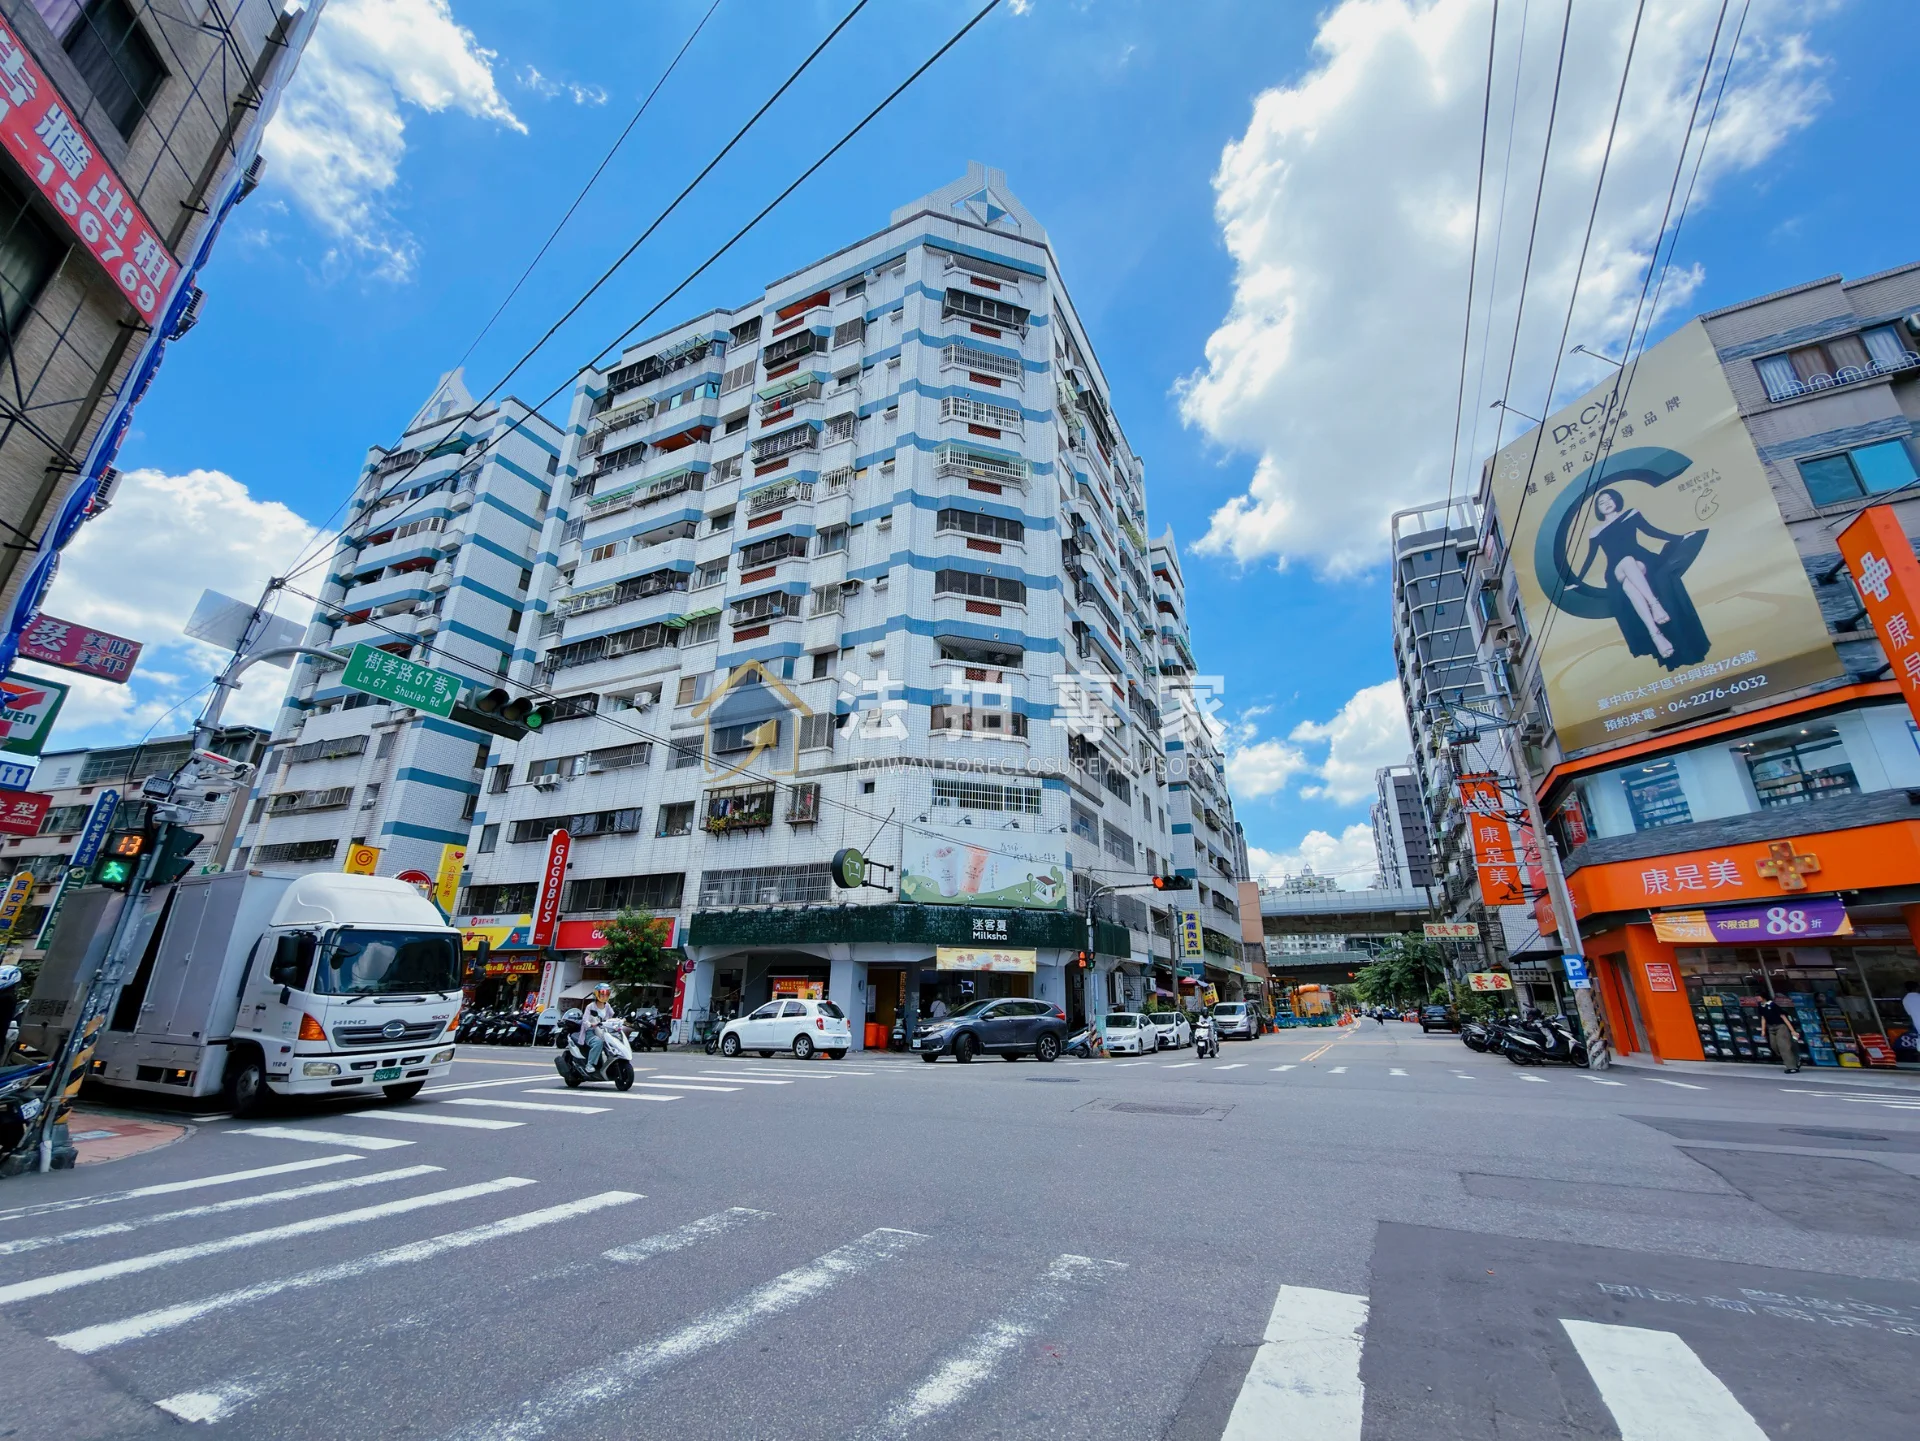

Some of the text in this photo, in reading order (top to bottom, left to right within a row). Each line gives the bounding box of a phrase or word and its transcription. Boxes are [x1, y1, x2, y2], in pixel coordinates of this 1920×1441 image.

[365, 651, 448, 694] 樹孝路67巷
[394, 684, 426, 703] Shuxiao
[429, 696, 441, 708] Rd
[118, 836, 143, 856] 13
[1478, 826, 1512, 887] 康是美
[542, 844, 566, 923] GOGOBUS
[1641, 859, 1744, 896] 康是美
[972, 918, 1008, 932] 迷客夏
[1766, 907, 1807, 935] 88
[1811, 919, 1822, 929] 折
[972, 931, 1008, 941] Milksha
[1567, 959, 1581, 976] P
[1473, 974, 1507, 990] 素食
